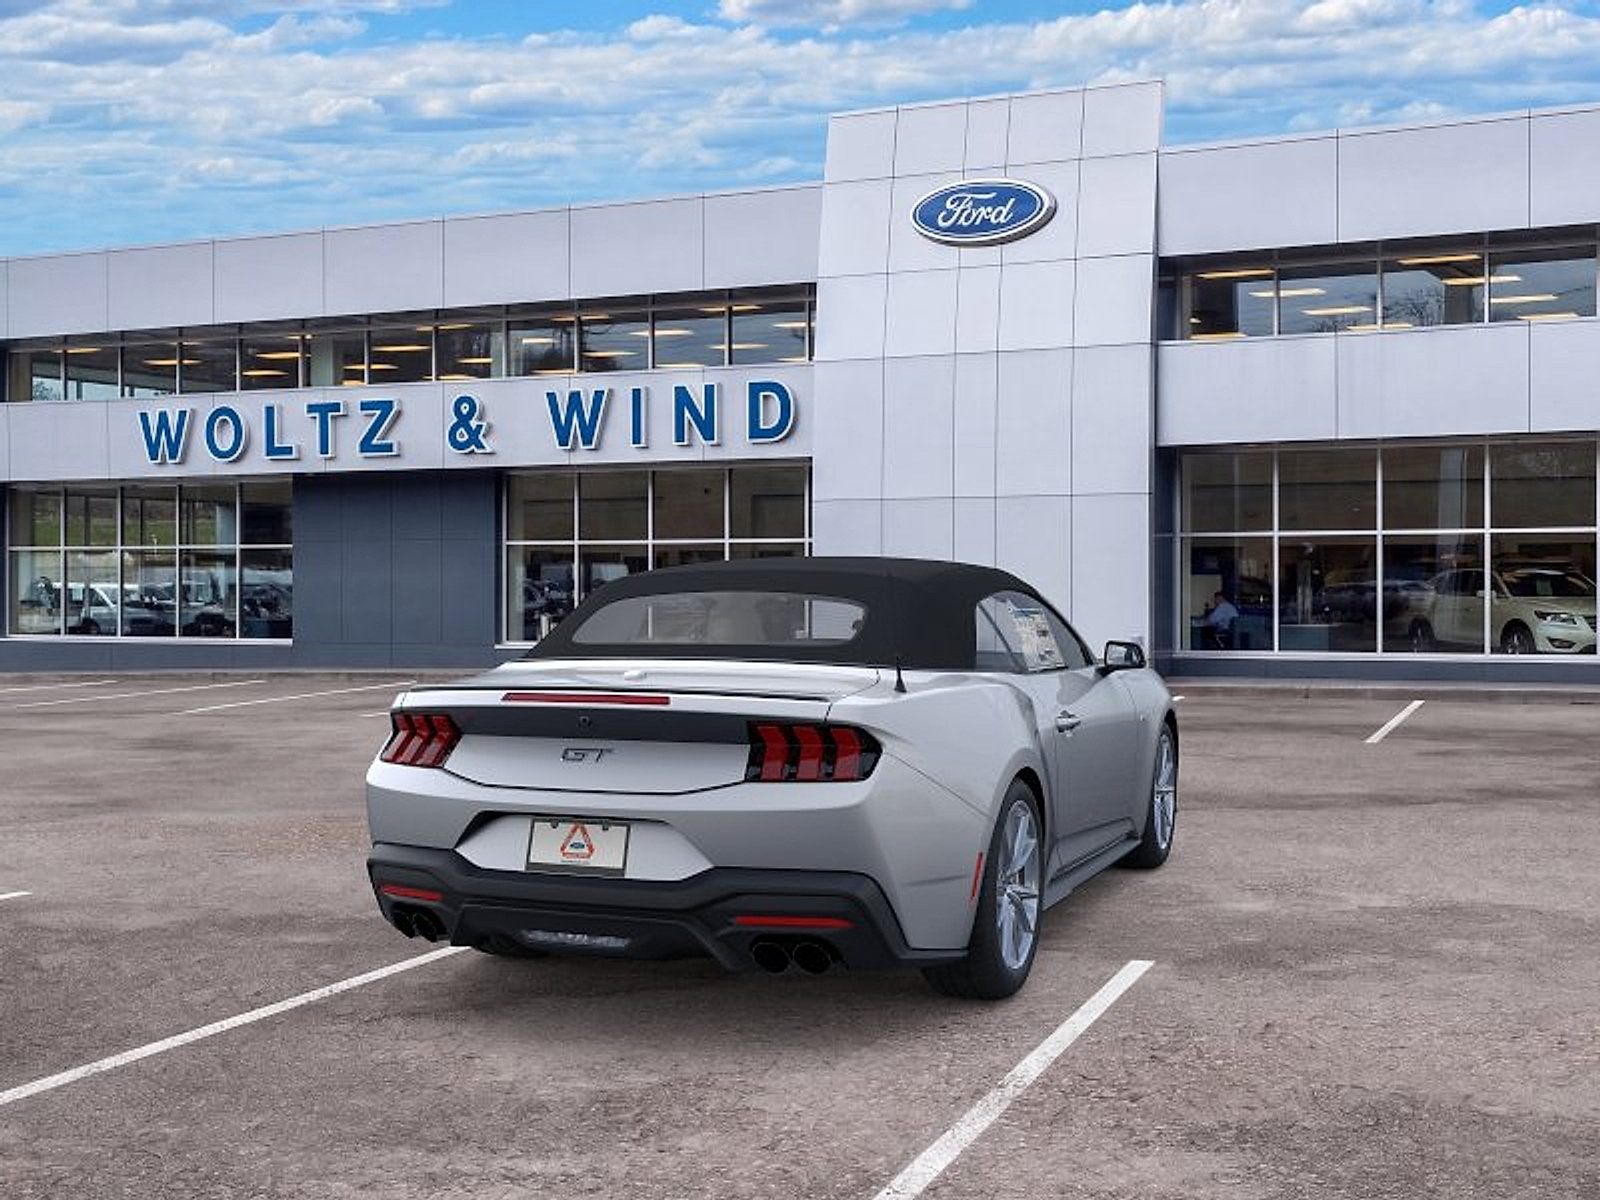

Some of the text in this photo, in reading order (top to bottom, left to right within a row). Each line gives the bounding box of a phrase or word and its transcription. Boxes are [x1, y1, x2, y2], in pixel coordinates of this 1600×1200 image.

[938, 192, 1015, 228] Ford
[138, 380, 794, 464] WOLTZ & WIND
[562, 748, 615, 762] GT
